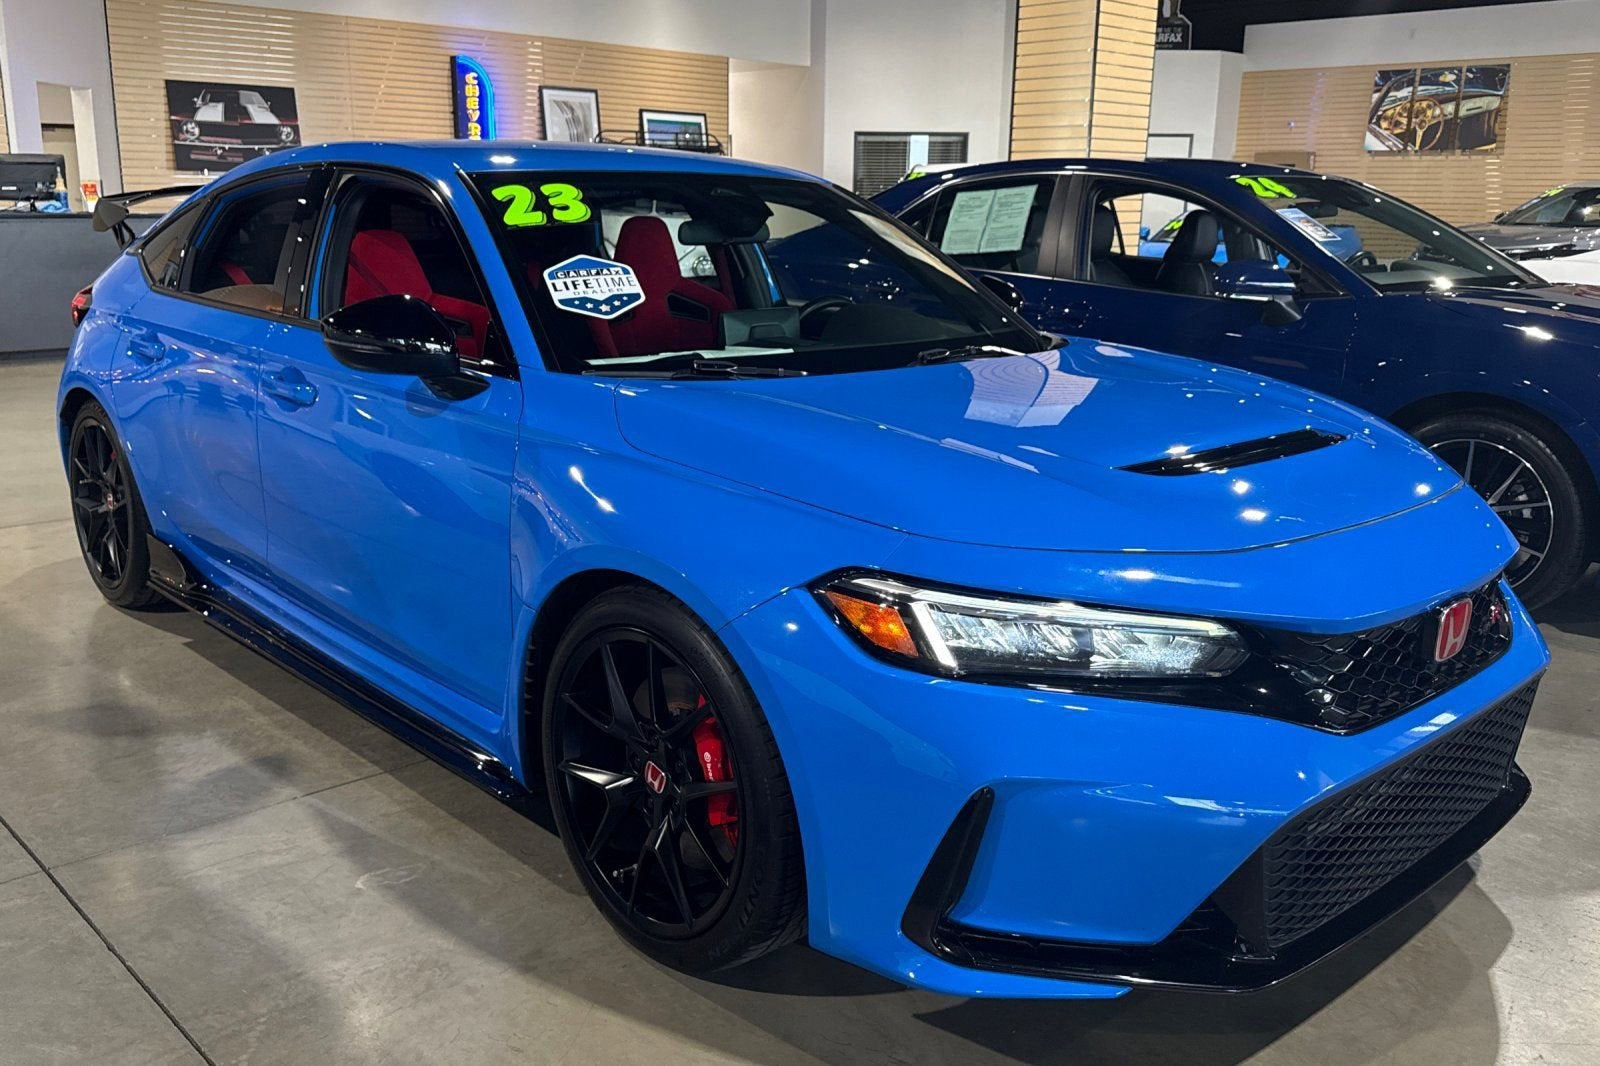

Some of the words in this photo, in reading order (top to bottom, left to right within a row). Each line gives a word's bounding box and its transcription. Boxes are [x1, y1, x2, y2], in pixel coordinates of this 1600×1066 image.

[1156, 33, 1182, 42] RFAX
[465, 72, 481, 140] CHEVR
[491, 183, 592, 227] 23
[555, 268, 623, 280] CARFAX
[551, 276, 637, 292] LIFETIME
[573, 288, 624, 296] DEALER
